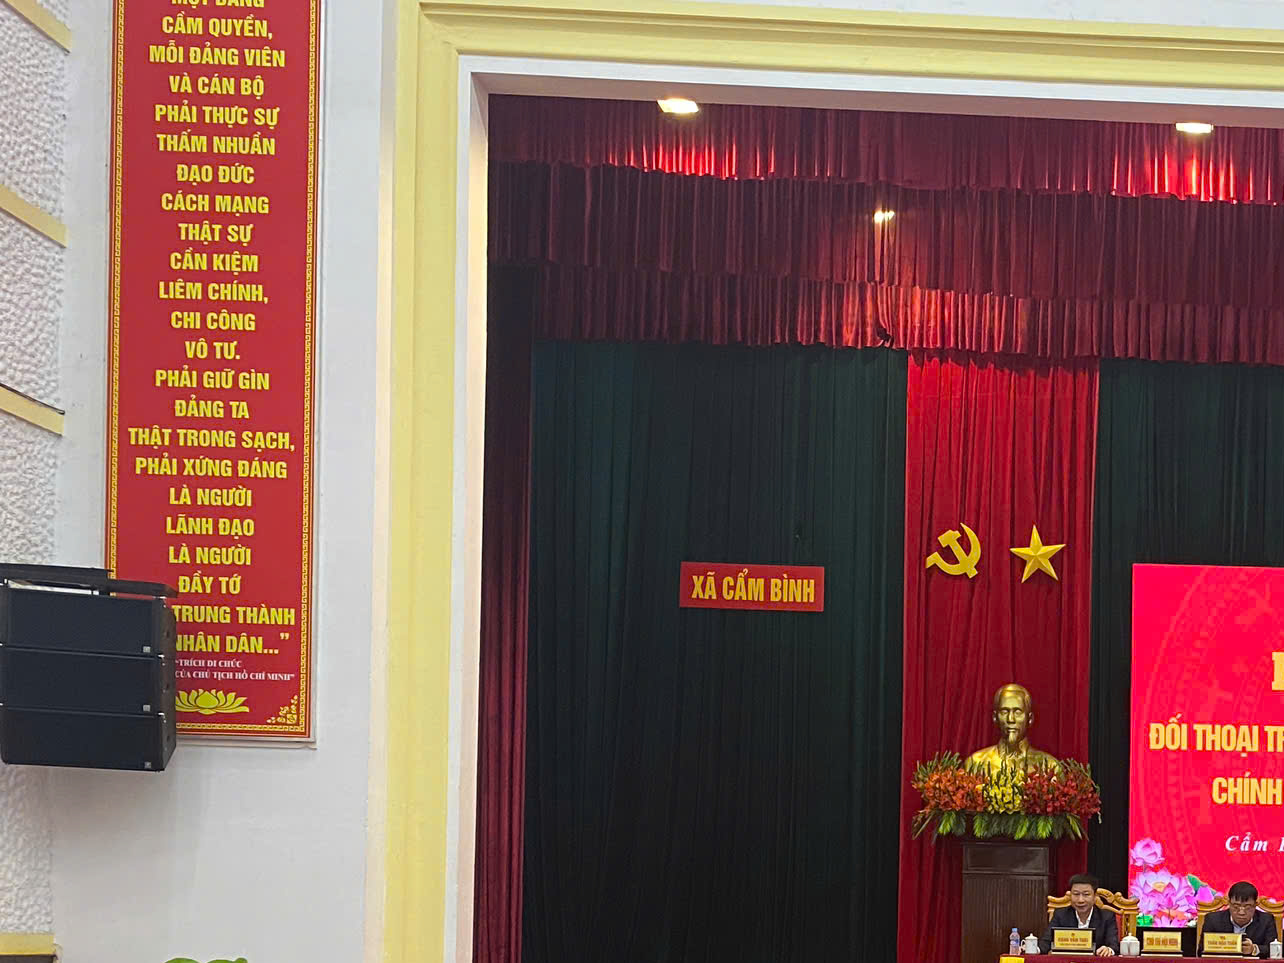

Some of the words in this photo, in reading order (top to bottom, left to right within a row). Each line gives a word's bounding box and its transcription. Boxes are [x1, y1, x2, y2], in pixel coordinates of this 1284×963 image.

[162, 12, 203, 35] CẦM
[208, 14, 273, 39] QUYỀN,
[149, 40, 184, 64] MỖI
[188, 43, 239, 66] ĐẢNG
[243, 45, 286, 68] VIÊN
[155, 100, 198, 123] PHẢI
[202, 105, 249, 127] THỰC
[253, 107, 281, 129] SỰ
[161, 191, 210, 212] CÁCH
[215, 194, 270, 217] MẠNG
[170, 247, 208, 271] CẦN
[212, 250, 259, 274] KIỆM
[159, 279, 203, 300] LIÊM
[207, 279, 269, 303] CHÍNH,
[184, 337, 209, 359] VÔ
[213, 340, 241, 360] TƯ.
[155, 364, 198, 388] PHẢI
[202, 368, 236, 389] GIỮ
[238, 369, 270, 391] GÌN
[127, 425, 173, 449] THẬT
[176, 428, 236, 448] TRONG
[241, 431, 295, 453] SẠCH,
[135, 452, 178, 476] PHẢI
[183, 455, 233, 477] XỨNG
[237, 456, 288, 479] ĐÁNG
[169, 484, 192, 505] LÀ
[196, 485, 252, 507] NGƯỜI
[166, 514, 214, 535] LÃNH
[217, 517, 255, 540] ĐẠO
[178, 571, 214, 594] ĐẦY
[218, 574, 241, 595] TỚ
[691, 571, 717, 600] XÃ
[722, 567, 765, 602] CẨM
[770, 573, 815, 603] BÌNH
[172, 604, 231, 624] TRUNG
[235, 604, 296, 625] THÀNH
[1149, 714, 1188, 750] ĐỐI
[1193, 720, 1258, 757] THOẠI
[1212, 772, 1282, 806] CHÍNH
[1225, 834, 1271, 853] Cẩm
